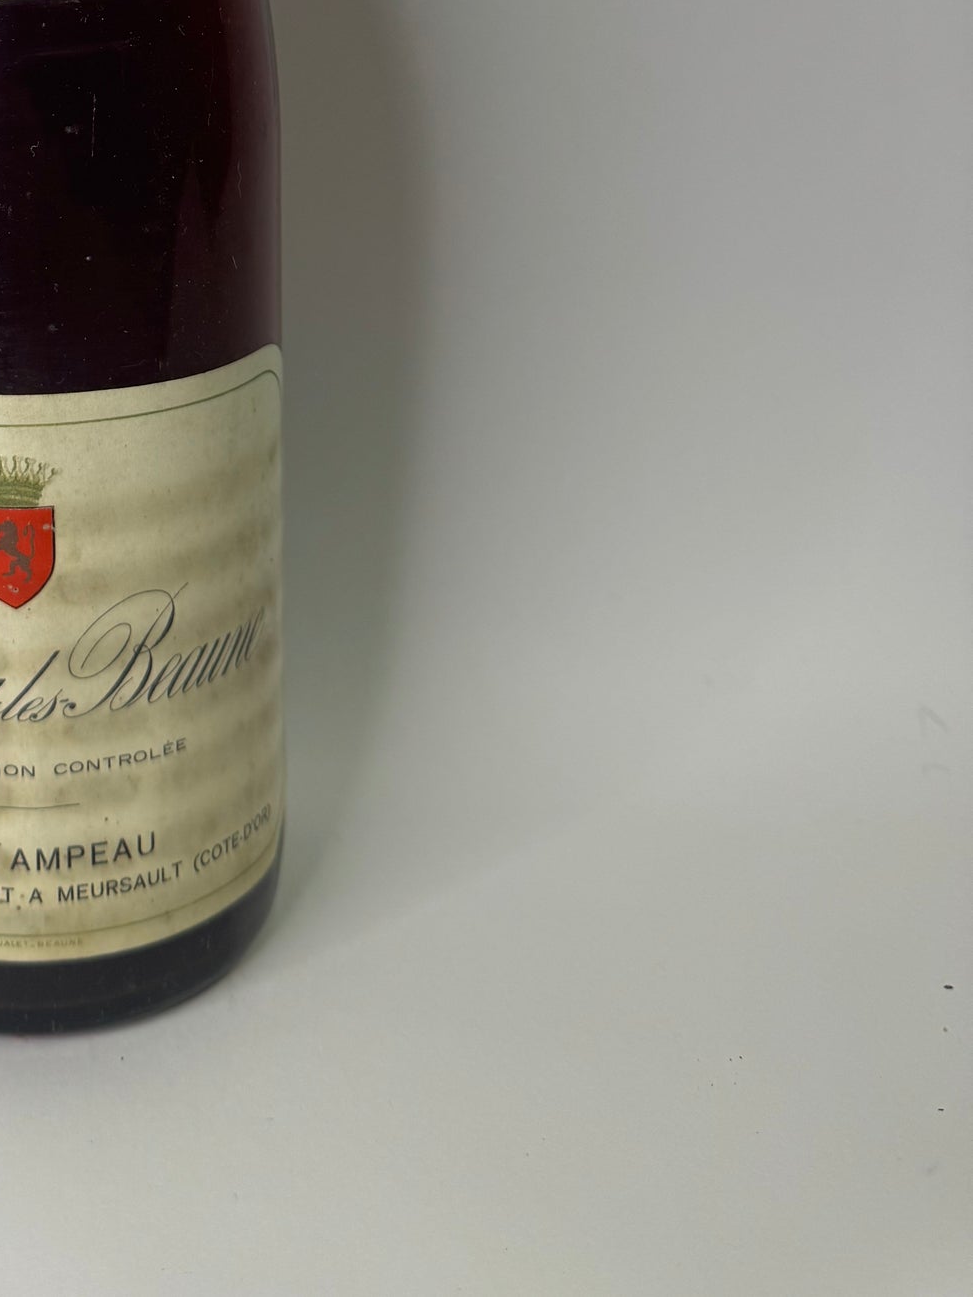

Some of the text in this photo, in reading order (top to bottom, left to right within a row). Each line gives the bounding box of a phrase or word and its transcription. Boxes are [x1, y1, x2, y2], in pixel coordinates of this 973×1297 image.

[53, 738, 187, 776] CONTROLÉE
[10, 830, 157, 872] AMPEAU
[57, 861, 183, 903] MEURSAULT
